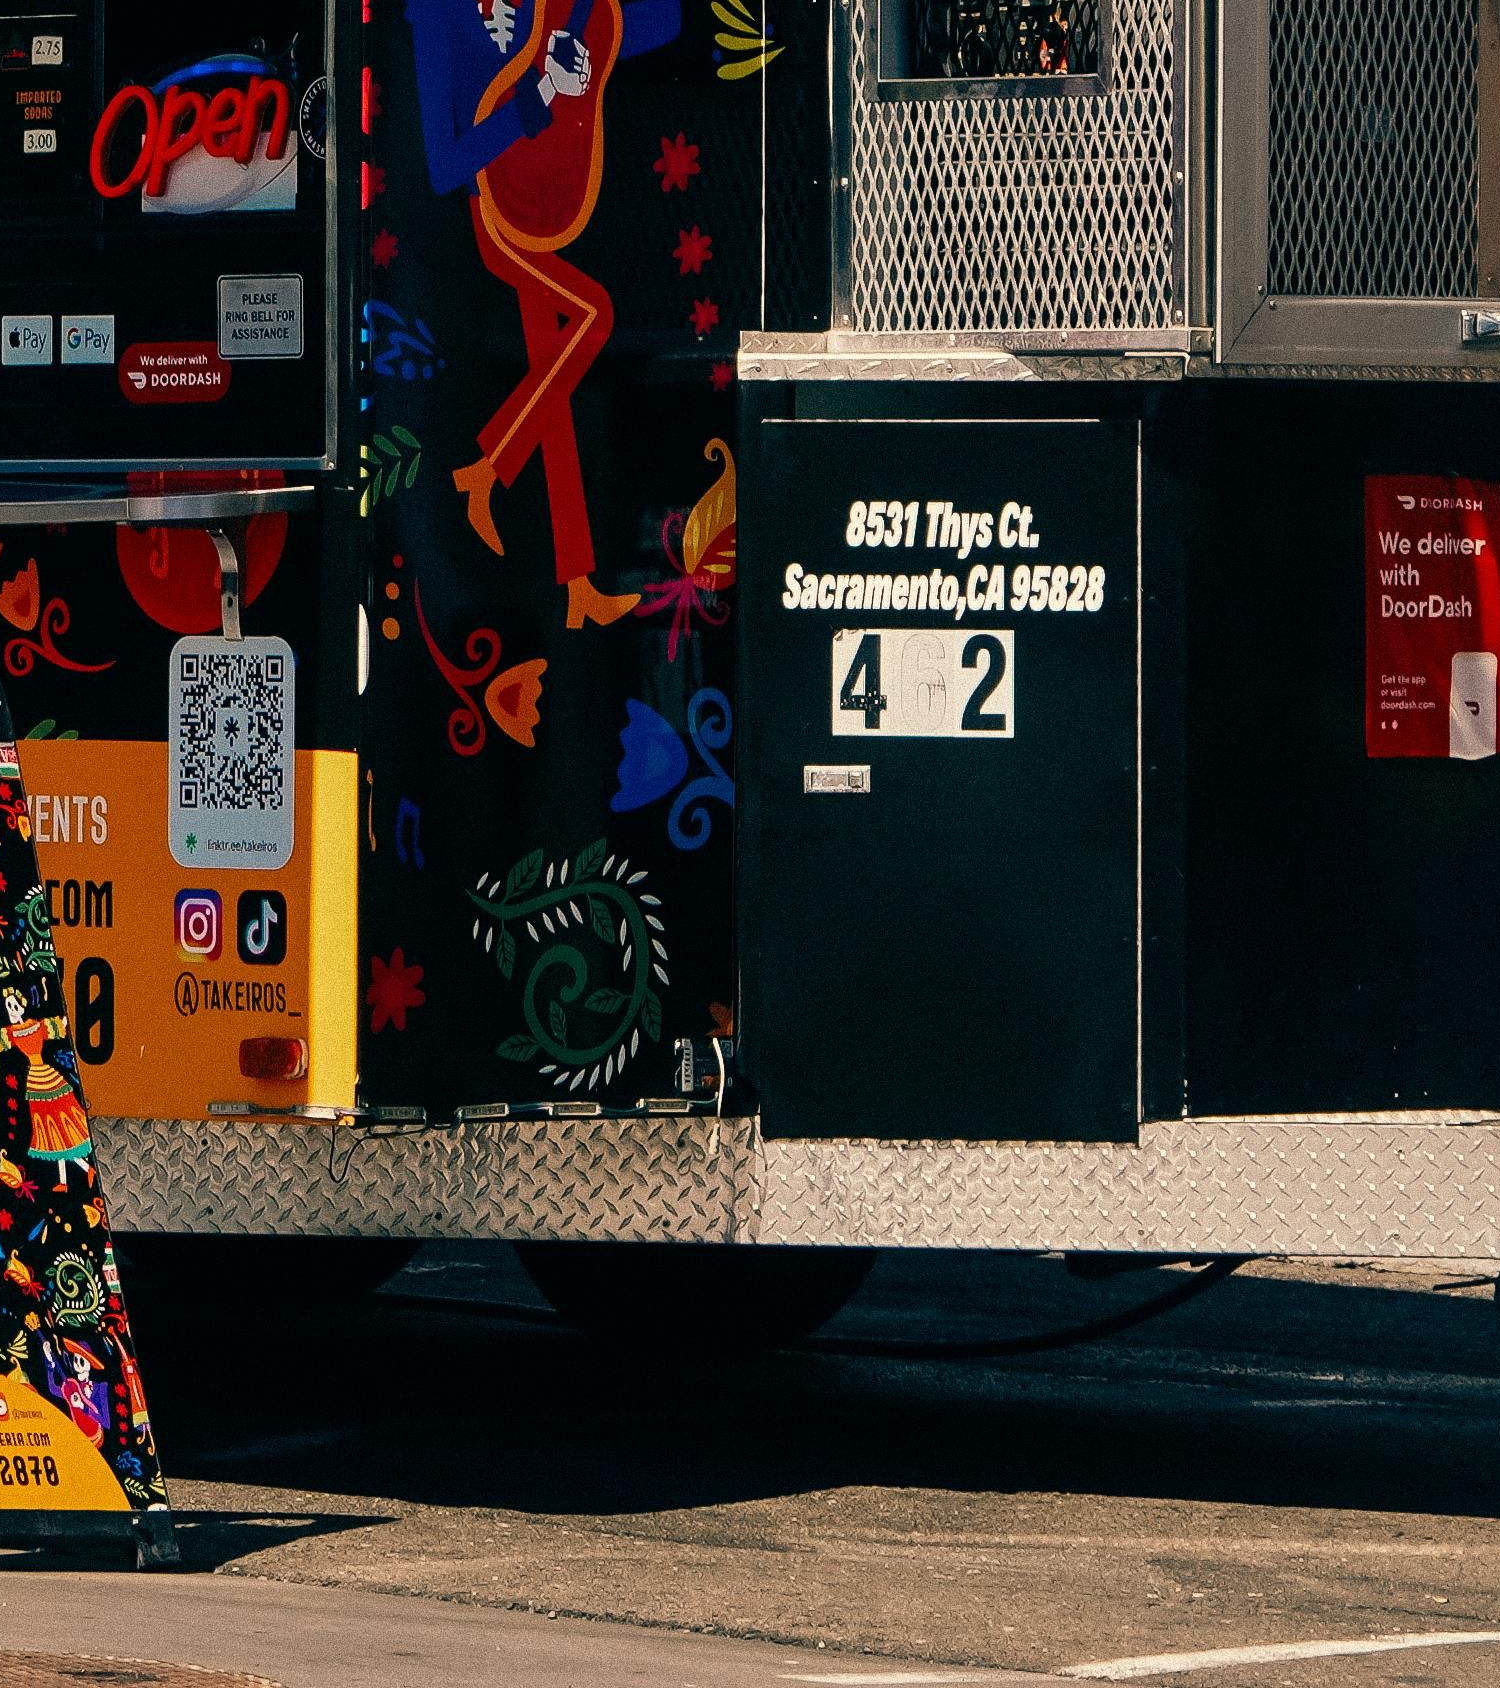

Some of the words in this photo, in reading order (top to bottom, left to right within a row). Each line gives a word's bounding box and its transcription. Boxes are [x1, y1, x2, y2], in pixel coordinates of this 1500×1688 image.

[36, 41, 60, 55] 2.75
[16, 90, 61, 105] IMPORTED
[24, 107, 53, 119] SODAS
[27, 135, 53, 151] 3.00
[91, 75, 292, 198] Open
[242, 294, 278, 304] PLEASE
[226, 311, 248, 322] RING
[251, 311, 273, 322] BELL
[277, 311, 295, 321] FOR
[232, 328, 289, 340] ASSISTANCE
[23, 331, 47, 353] Pay
[85, 331, 110, 353] Pay
[140, 356, 155, 366] We
[157, 355, 186, 366] deliver
[189, 355, 208, 365] with
[152, 373, 221, 387] DOORDASH
[846, 501, 919, 548] 8531
[926, 501, 993, 560] Thys
[999, 501, 1040, 548] Ct.
[1379, 531, 1411, 555] We
[1417, 532, 1486, 555] deliver
[1380, 563, 1420, 586] with
[783, 563, 1005, 621] Sacramento,CA
[1010, 565, 1106, 612] 95828
[1382, 594, 1472, 618] DoorDash
[1381, 675, 1396, 684] Get
[1412, 676, 1426, 686] app
[1381, 688, 1389, 696] or
[1381, 700, 1435, 710] doordash.com
